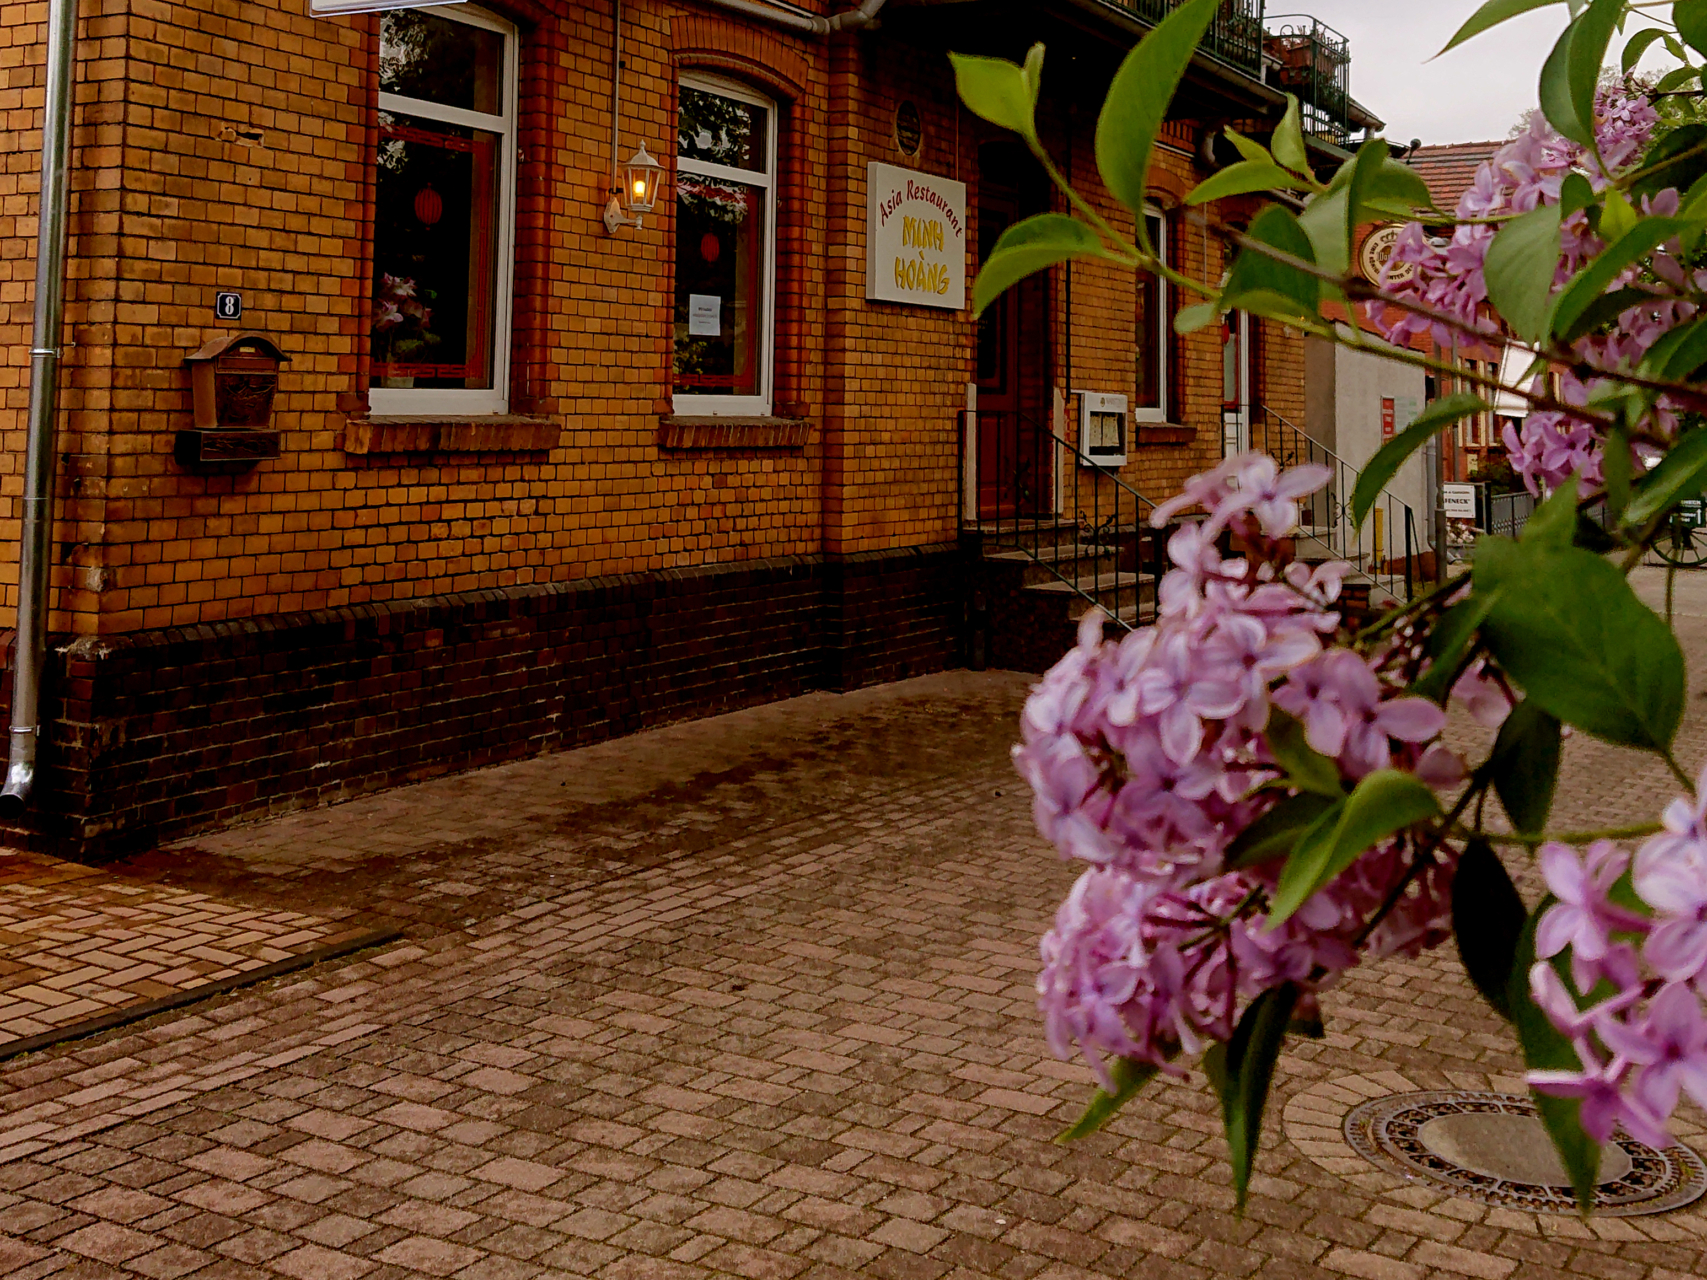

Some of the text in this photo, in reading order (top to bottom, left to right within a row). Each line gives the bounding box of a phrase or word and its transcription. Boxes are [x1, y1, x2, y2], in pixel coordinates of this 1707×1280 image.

[879, 179, 963, 238] Asia Restaurant
[902, 215, 944, 252] MINH
[894, 250, 950, 295] HOÀNG
[225, 296, 234, 315] 8
